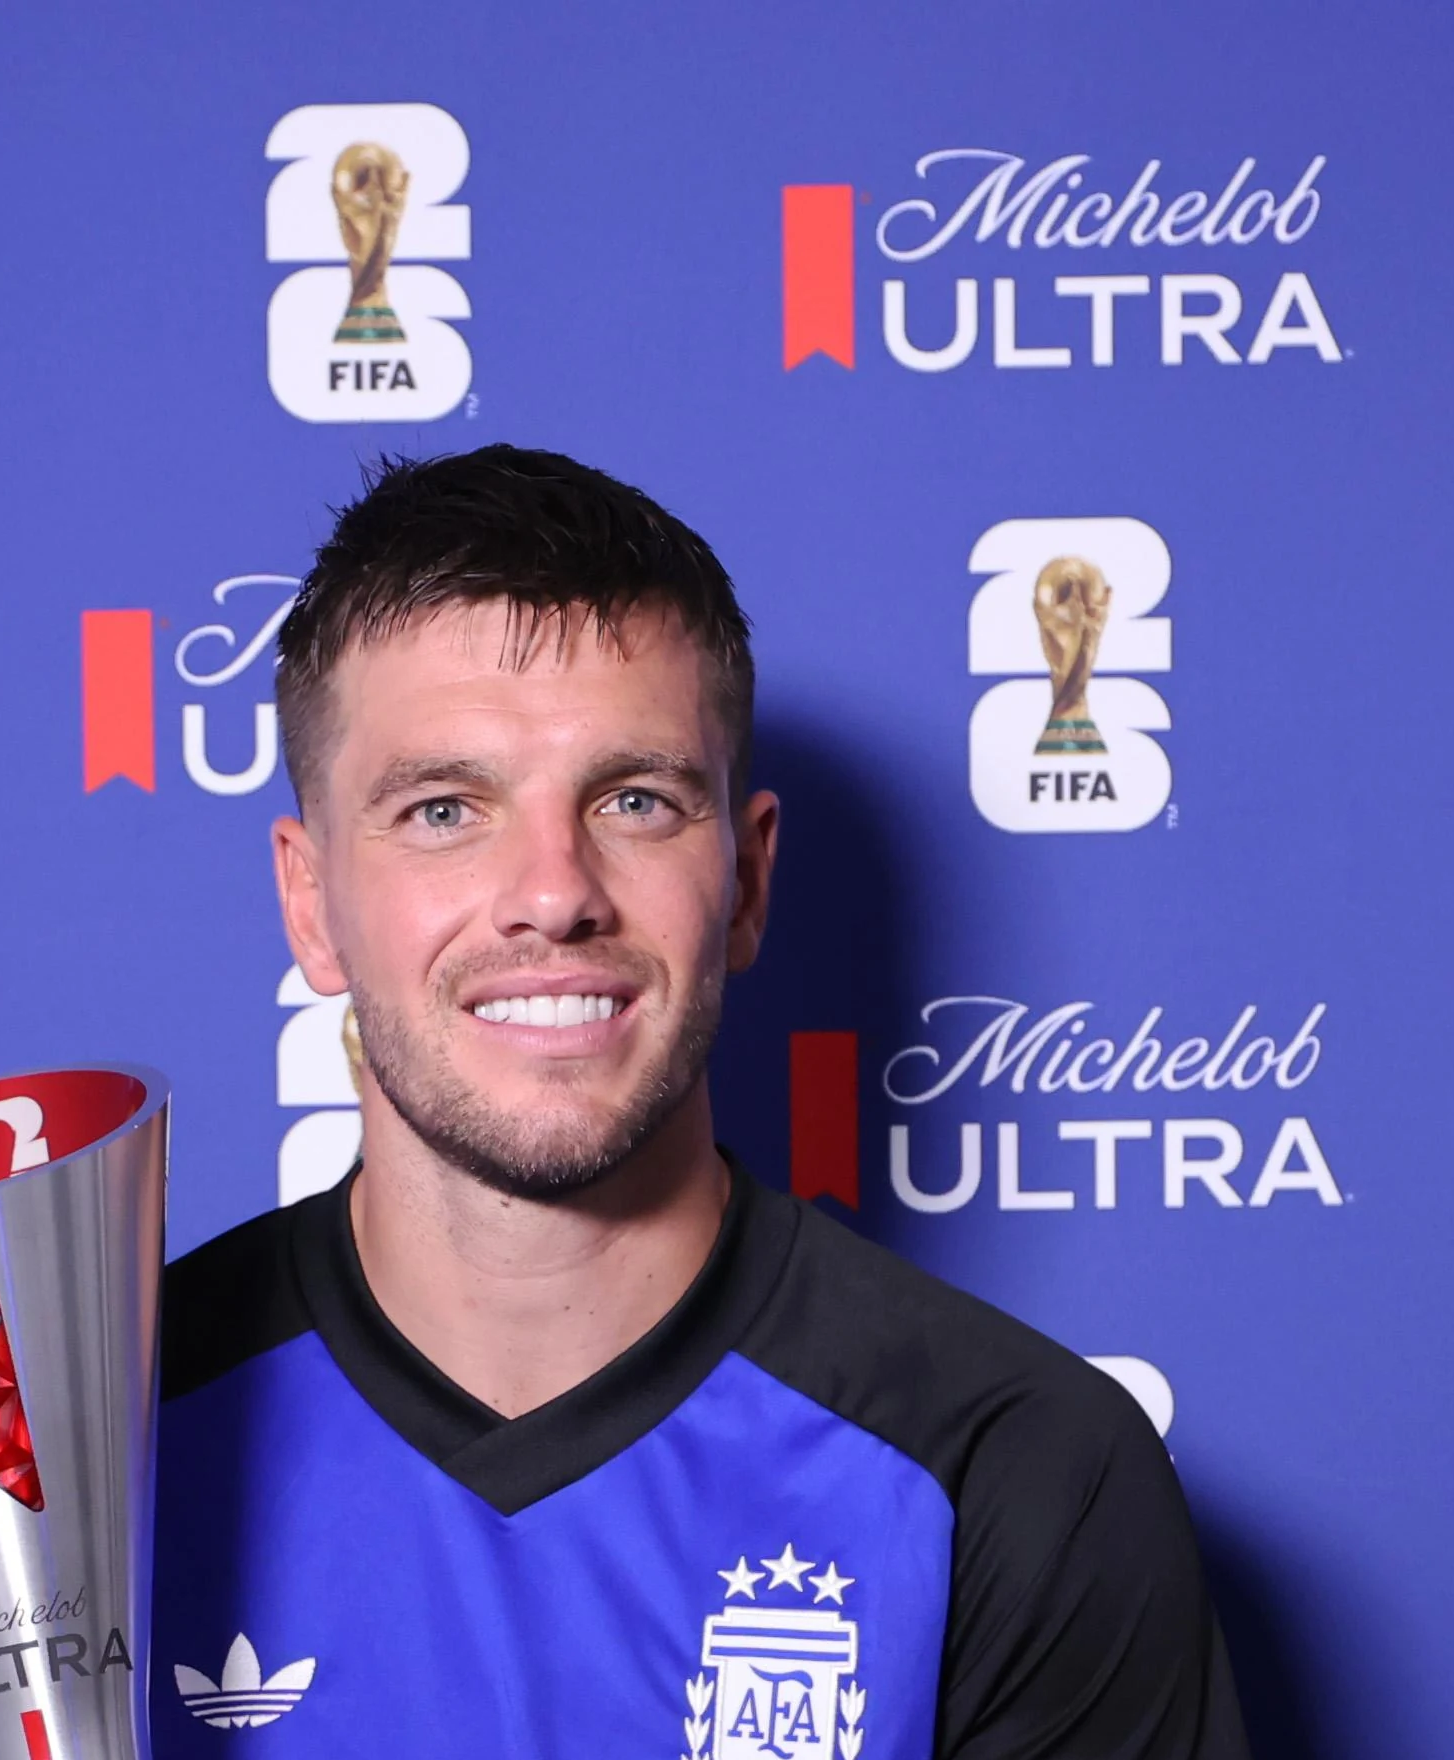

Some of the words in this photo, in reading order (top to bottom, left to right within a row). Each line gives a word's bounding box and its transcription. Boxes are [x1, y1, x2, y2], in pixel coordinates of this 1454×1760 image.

[877, 149, 1326, 262] Michelob
[883, 272, 1342, 372] ULTRA
[329, 360, 416, 391] FIFA
[1029, 771, 1116, 803] FIFA
[885, 997, 1326, 1103] Michelob
[890, 1117, 1343, 1212] ULTRA
